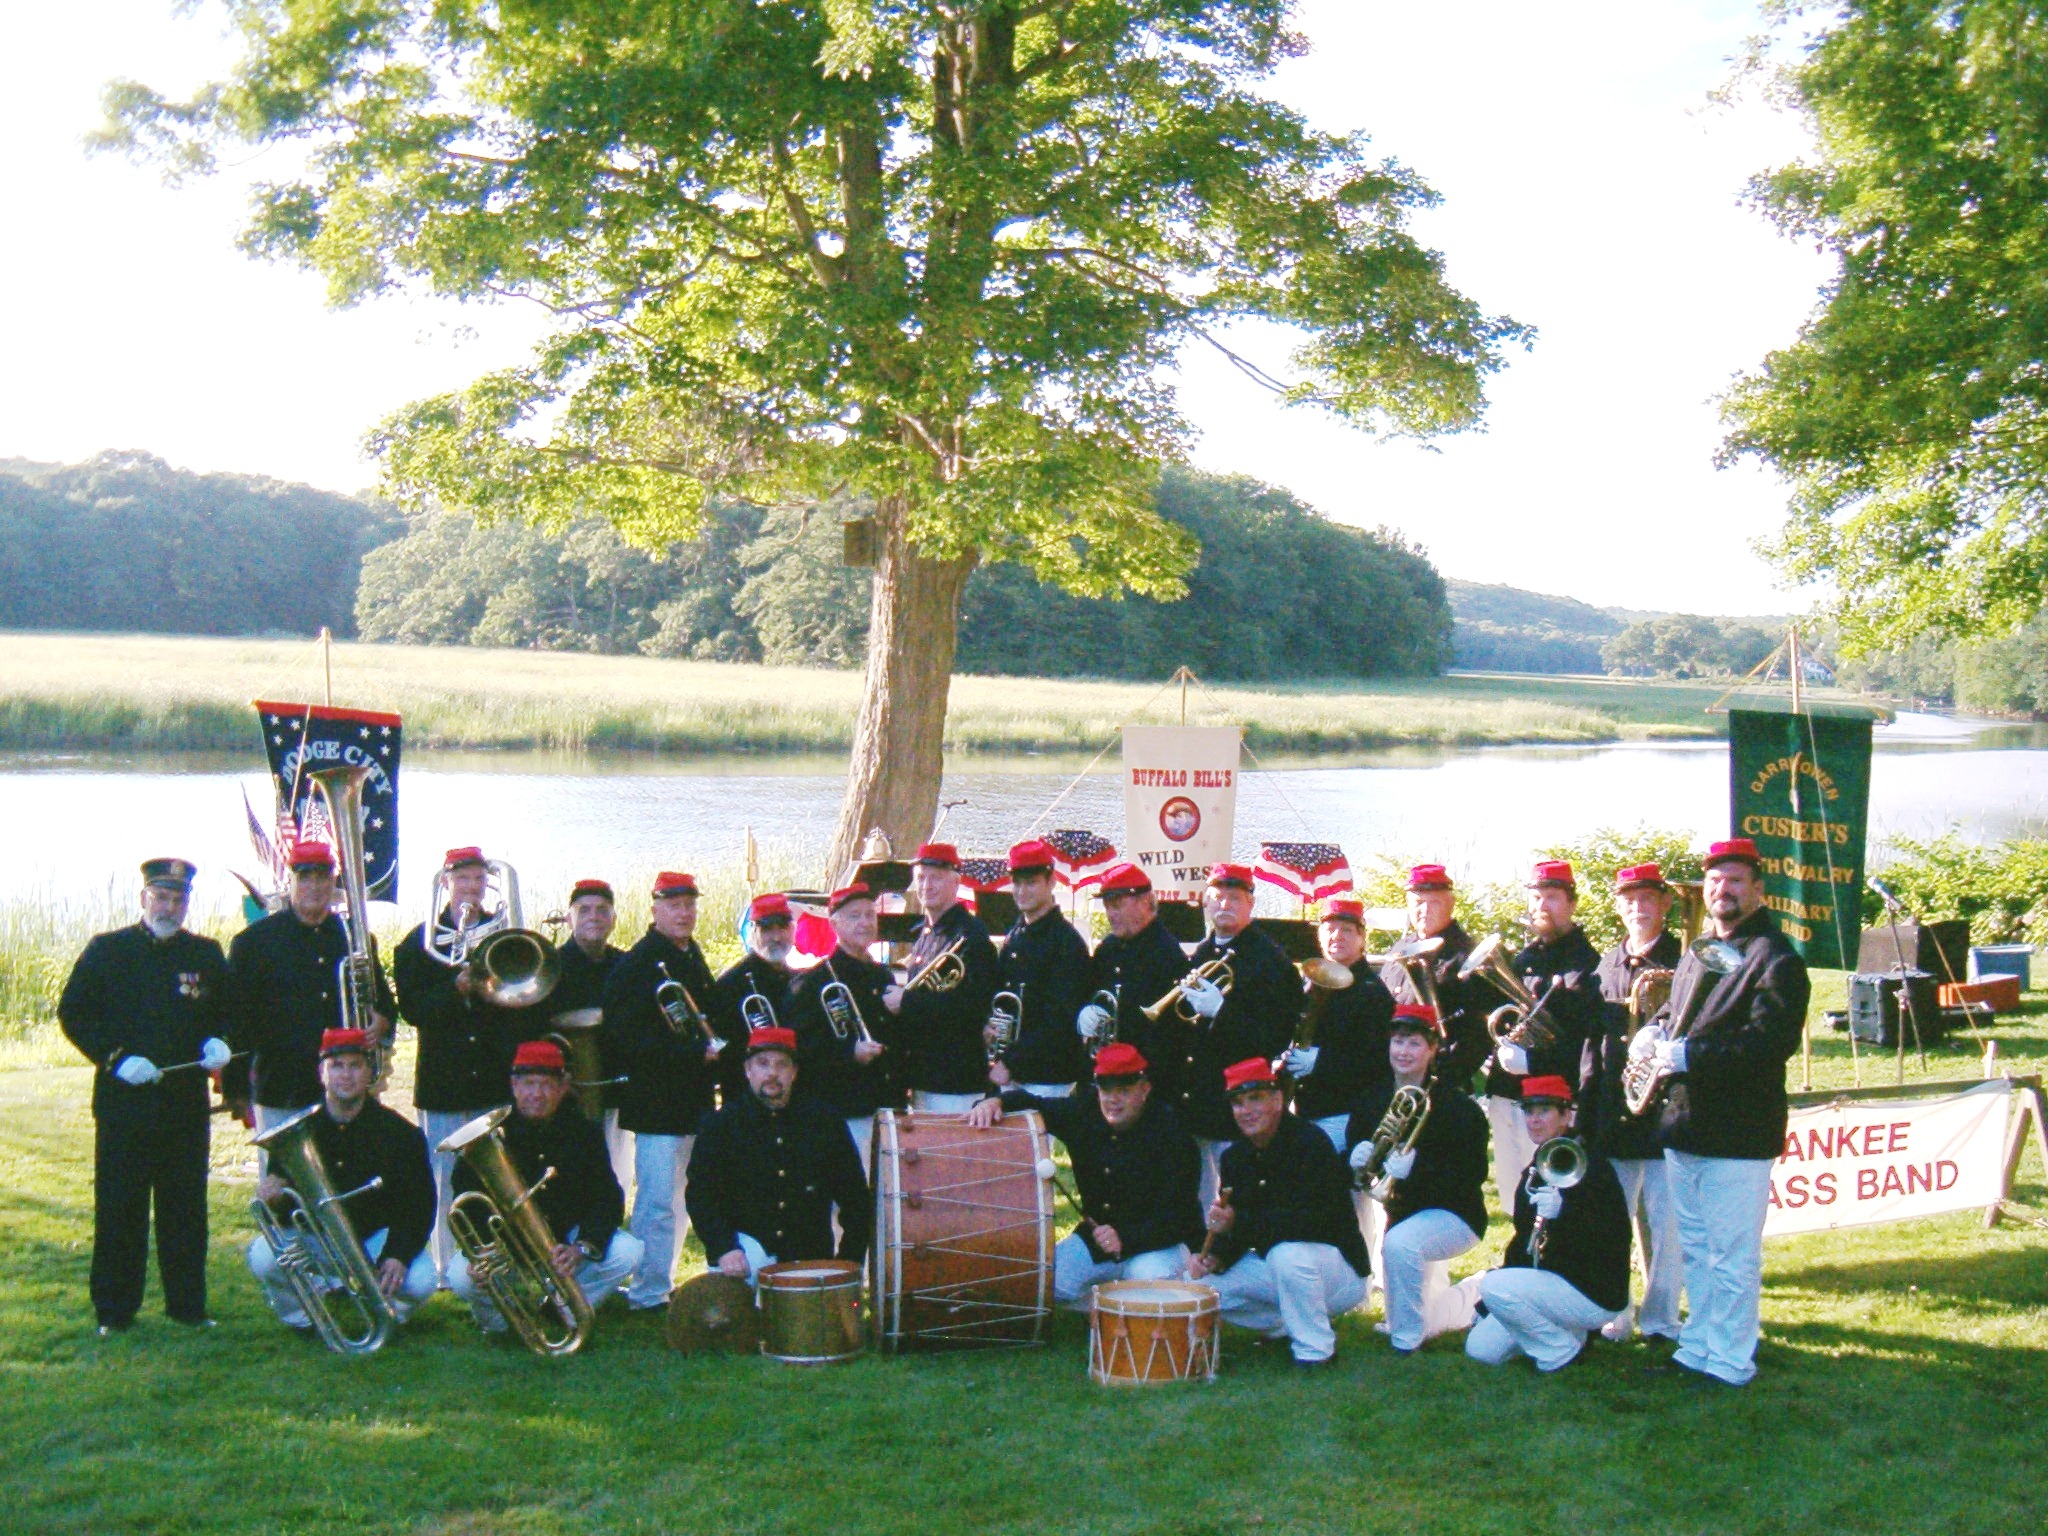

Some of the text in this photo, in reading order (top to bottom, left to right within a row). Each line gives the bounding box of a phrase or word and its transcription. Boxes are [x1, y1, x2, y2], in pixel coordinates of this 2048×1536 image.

[1132, 768, 1232, 788] BUFFALO BILL'S
[1743, 815, 1849, 844] CUSTER'S
[1137, 850, 1185, 867] WILD
[1760, 857, 1780, 875] TH
[1171, 865, 1211, 882] WES
[1779, 1121, 1912, 1165] ANKEE
[1768, 1159, 1960, 1210] ASS BAND
